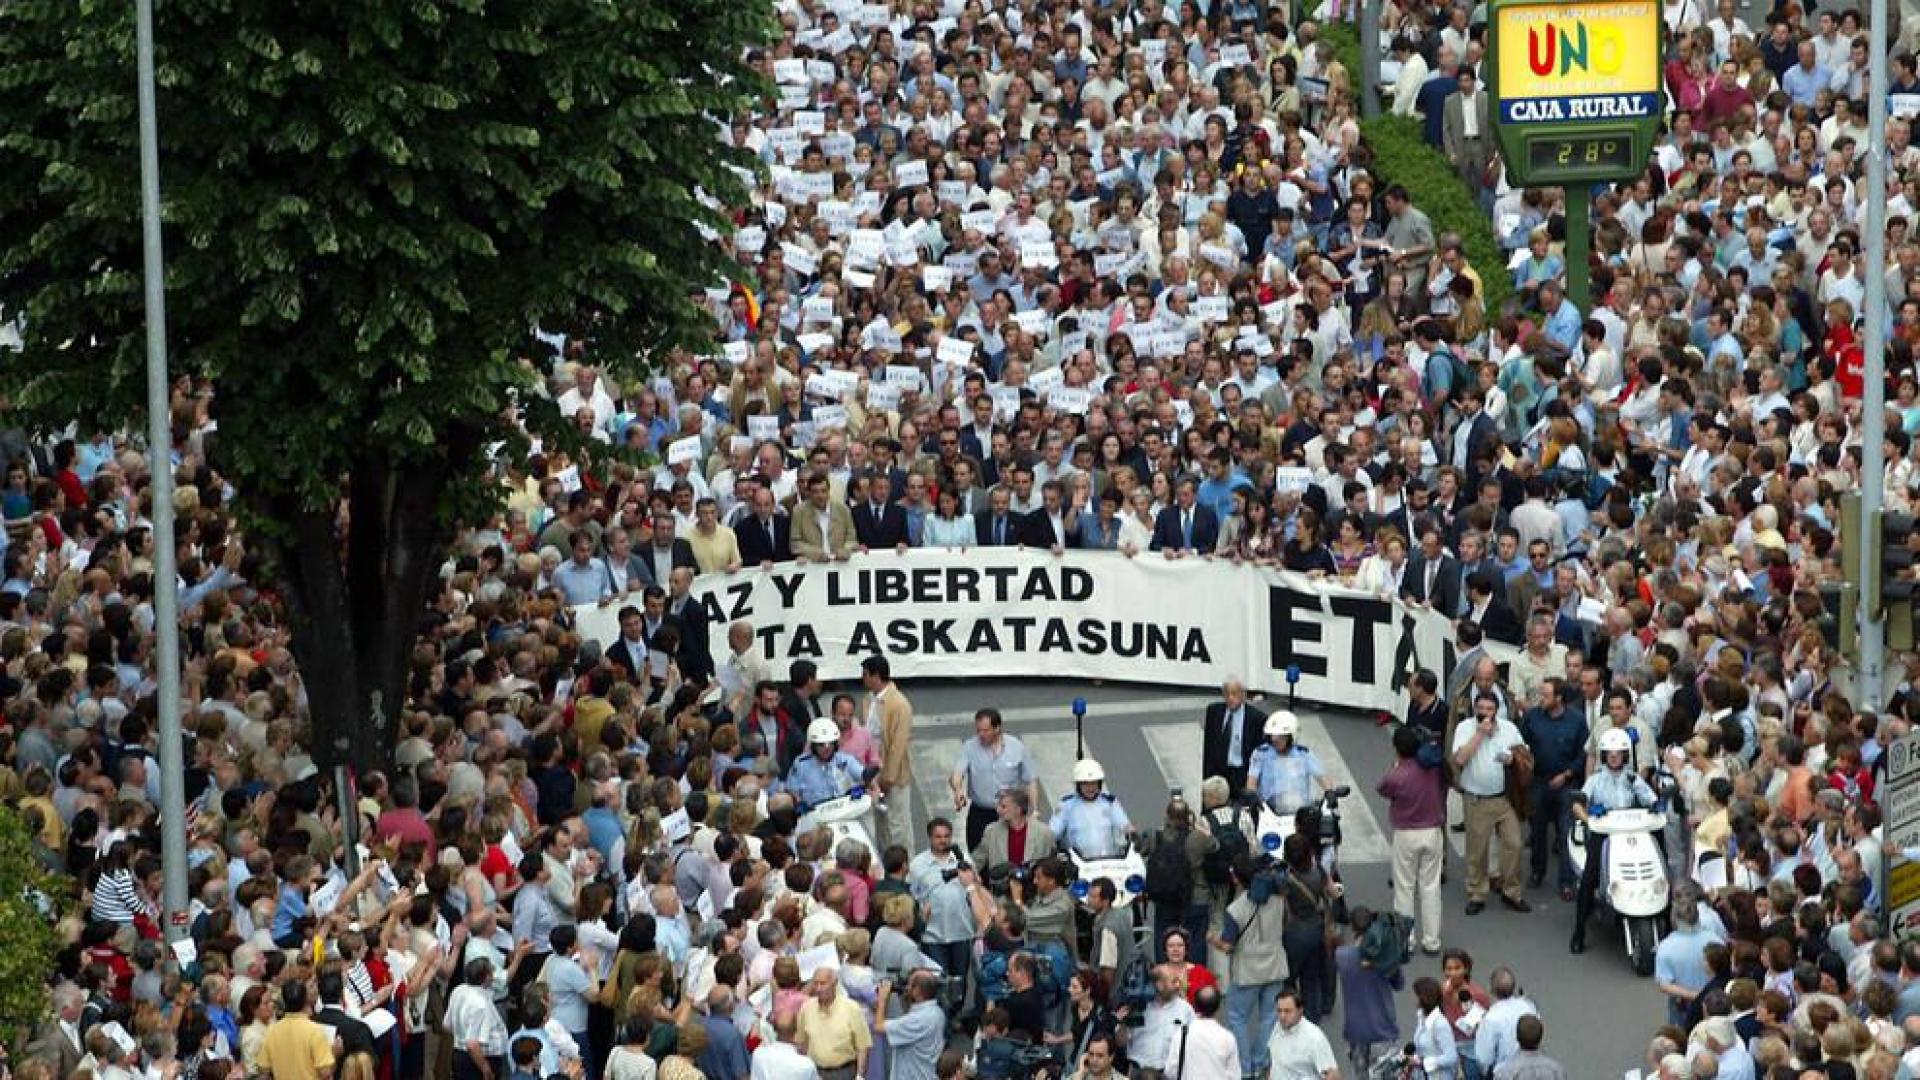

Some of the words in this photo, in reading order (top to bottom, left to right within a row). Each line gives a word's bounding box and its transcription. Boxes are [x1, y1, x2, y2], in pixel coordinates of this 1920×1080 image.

[1529, 20, 1627, 77] UNO
[1510, 100, 1564, 121] CAJA
[1569, 96, 1648, 118] RURAL
[701, 581, 754, 624] AZ
[772, 573, 805, 608] Y
[826, 566, 1095, 606] LIBERTAD
[756, 624, 823, 660] TA
[846, 618, 1212, 664] ASKATASUNA
